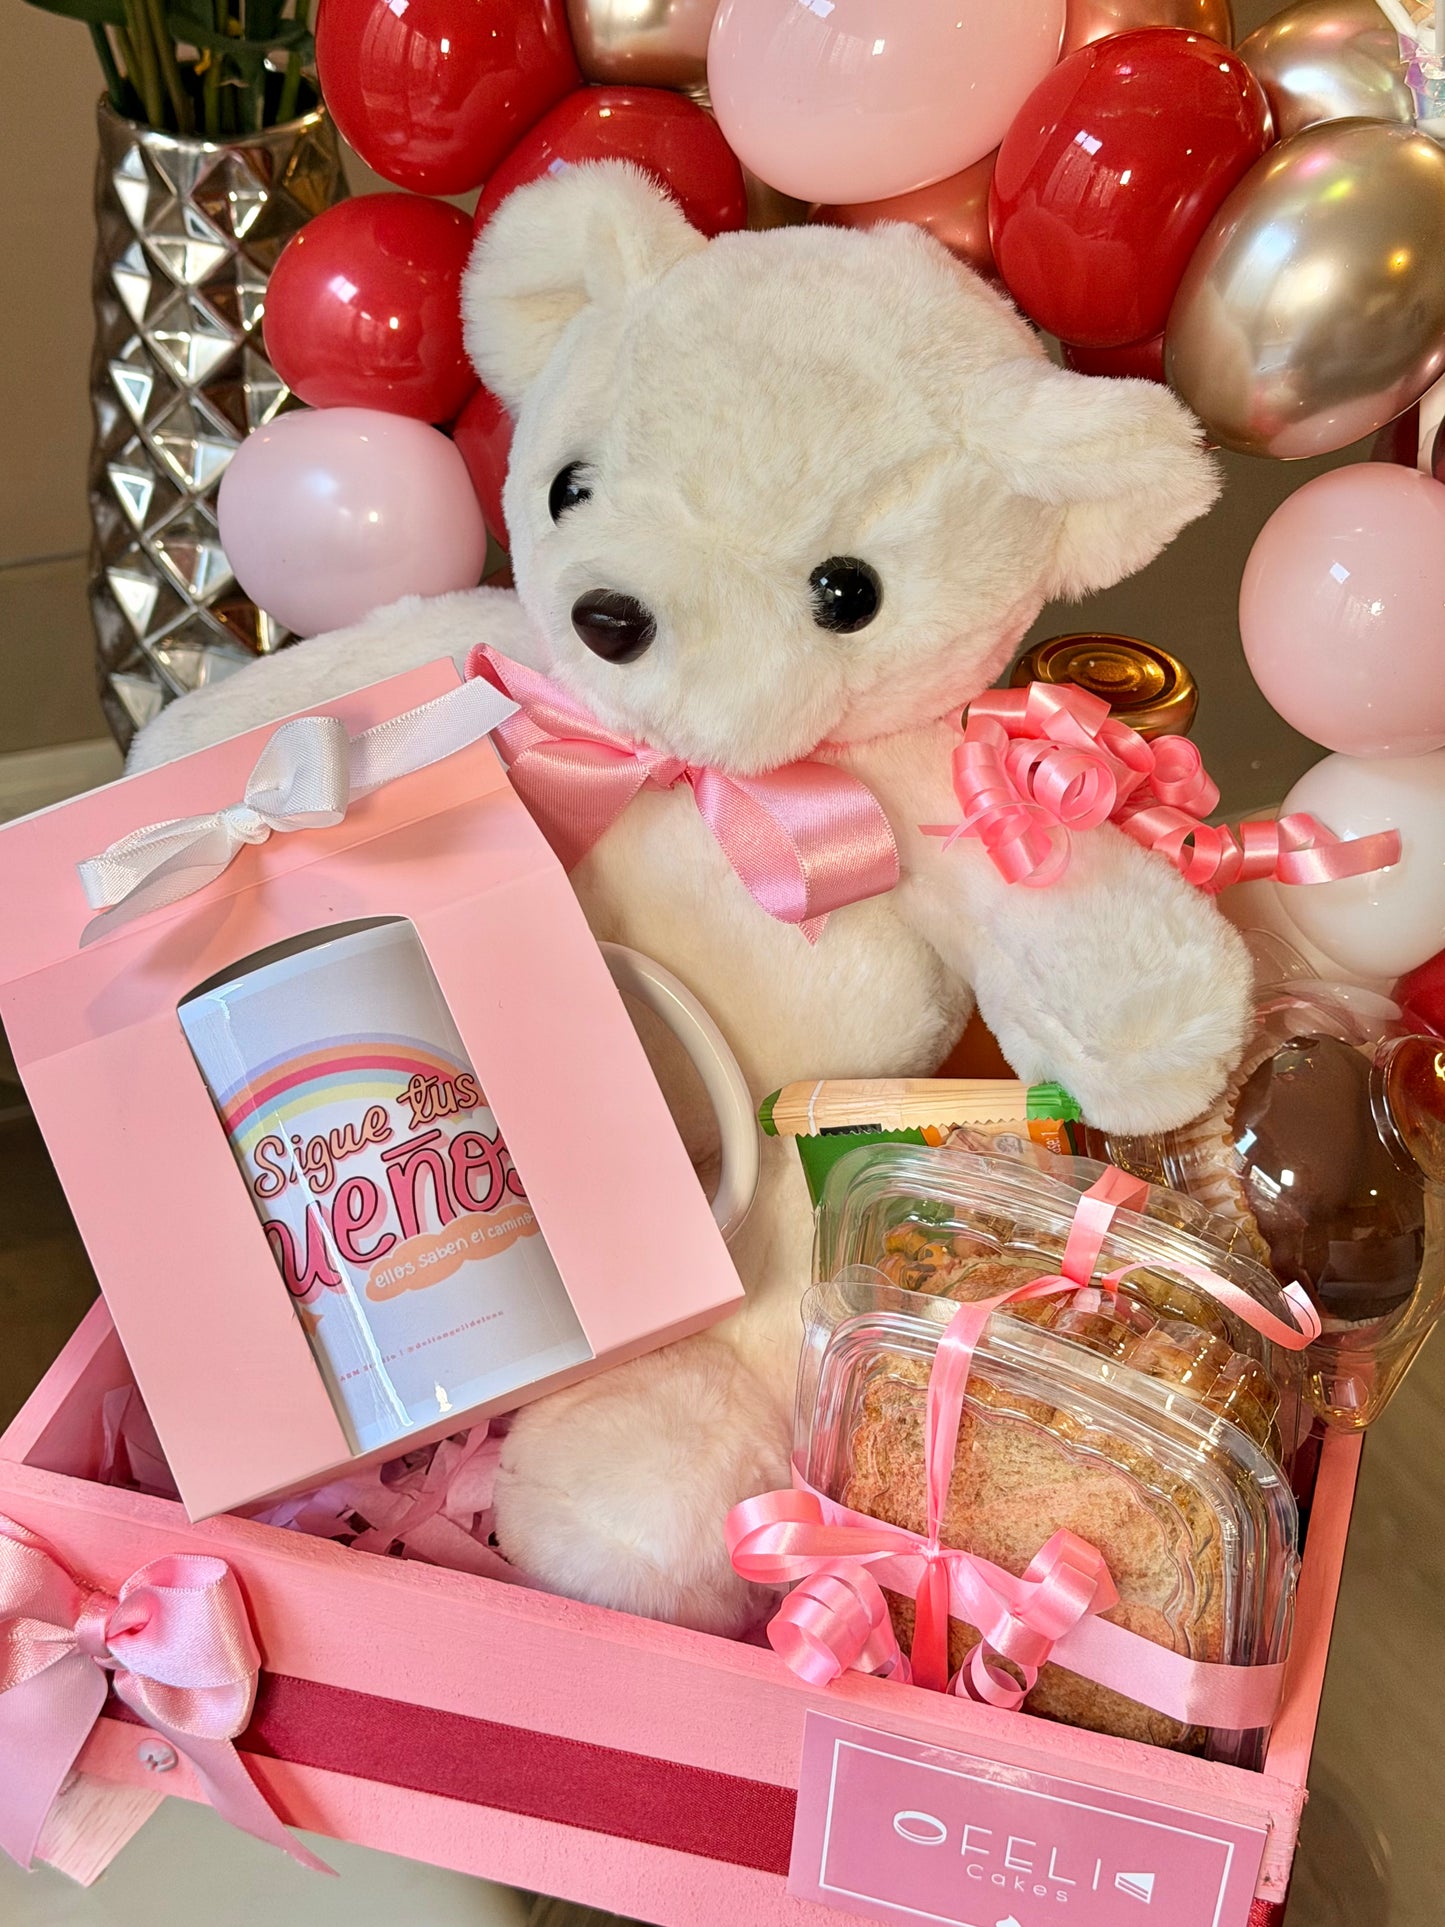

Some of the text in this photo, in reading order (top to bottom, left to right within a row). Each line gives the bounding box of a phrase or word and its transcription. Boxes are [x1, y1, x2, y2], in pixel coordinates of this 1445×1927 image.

[254, 1074, 479, 1198] Sigue tus
[263, 1128, 528, 1298] ueño
[375, 1212, 534, 1289] ellos saben el camino
[966, 1863, 1069, 1903] Cakes
